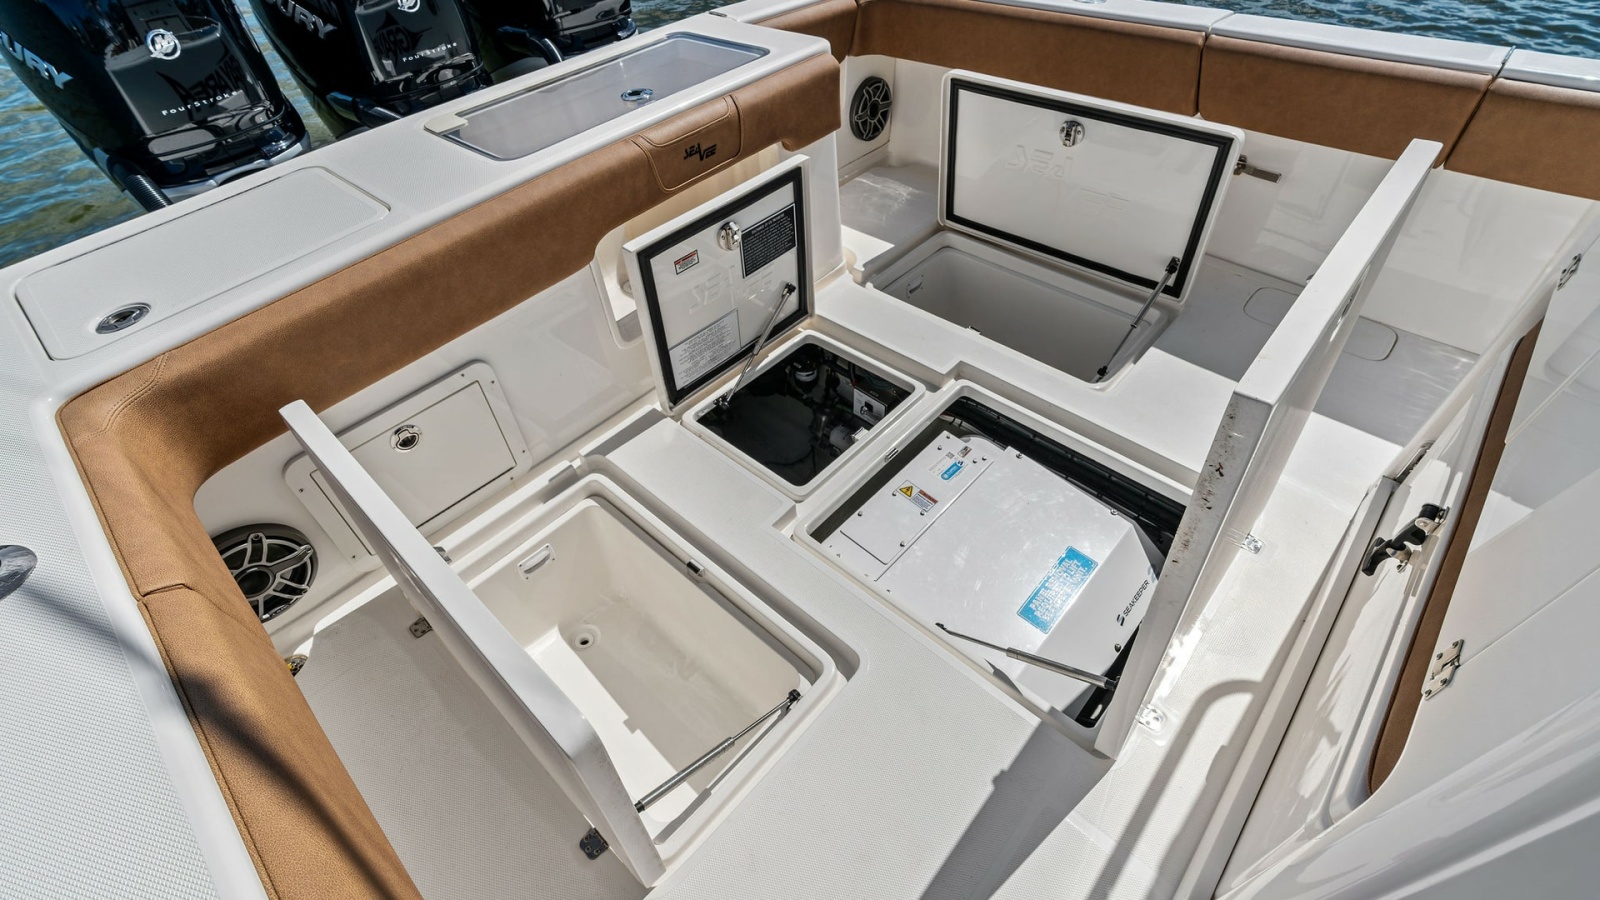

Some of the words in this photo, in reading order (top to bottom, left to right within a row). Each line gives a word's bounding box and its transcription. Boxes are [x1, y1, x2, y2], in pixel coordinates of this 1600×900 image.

[268, 0, 337, 39] URY
[0, 31, 73, 90] URY
[402, 42, 457, 62] FourStroke
[161, 91, 238, 116] FourStroke
[1123, 580, 1149, 617] SEAKEEPER
